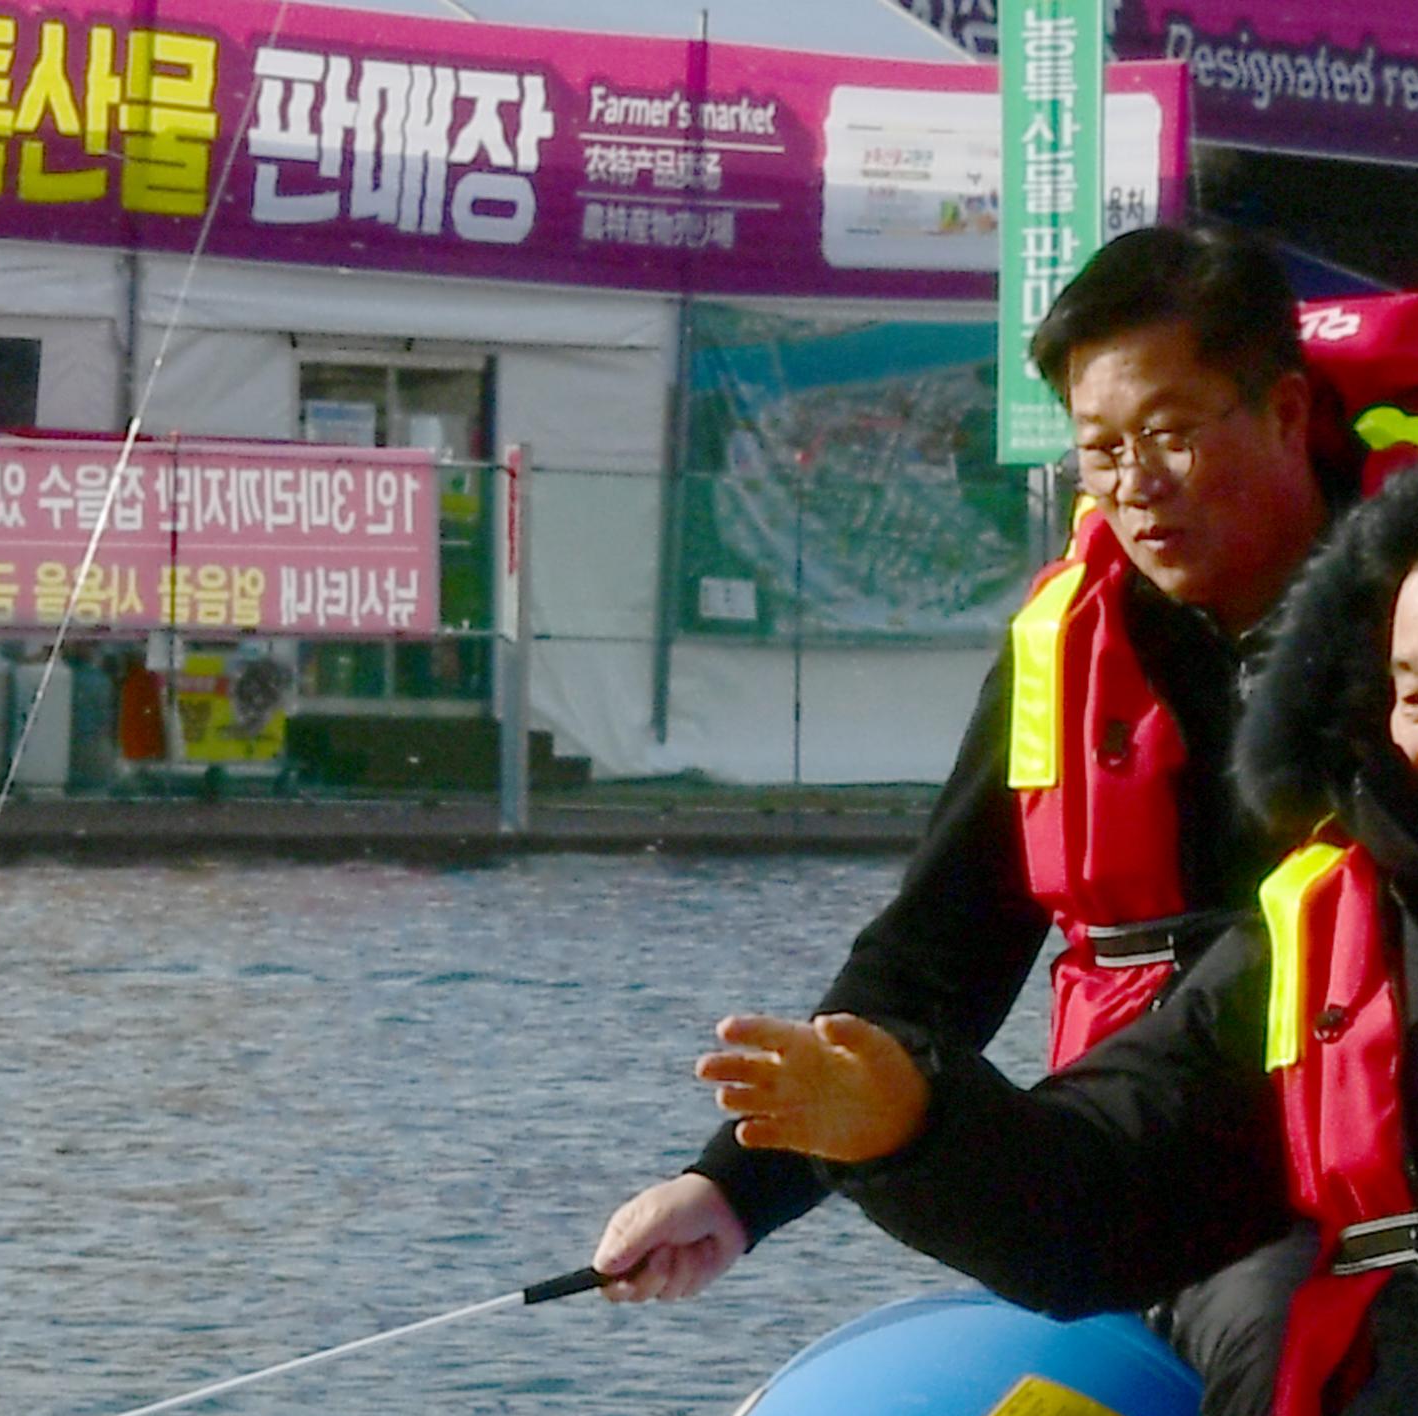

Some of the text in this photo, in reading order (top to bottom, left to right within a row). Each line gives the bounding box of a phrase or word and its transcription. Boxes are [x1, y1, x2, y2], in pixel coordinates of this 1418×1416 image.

[588, 85, 778, 135] Farmer's market
[1021, 8, 1081, 214] 농특산물
[1164, 24, 1374, 110] Designated
[248, 45, 554, 244] 판매장
